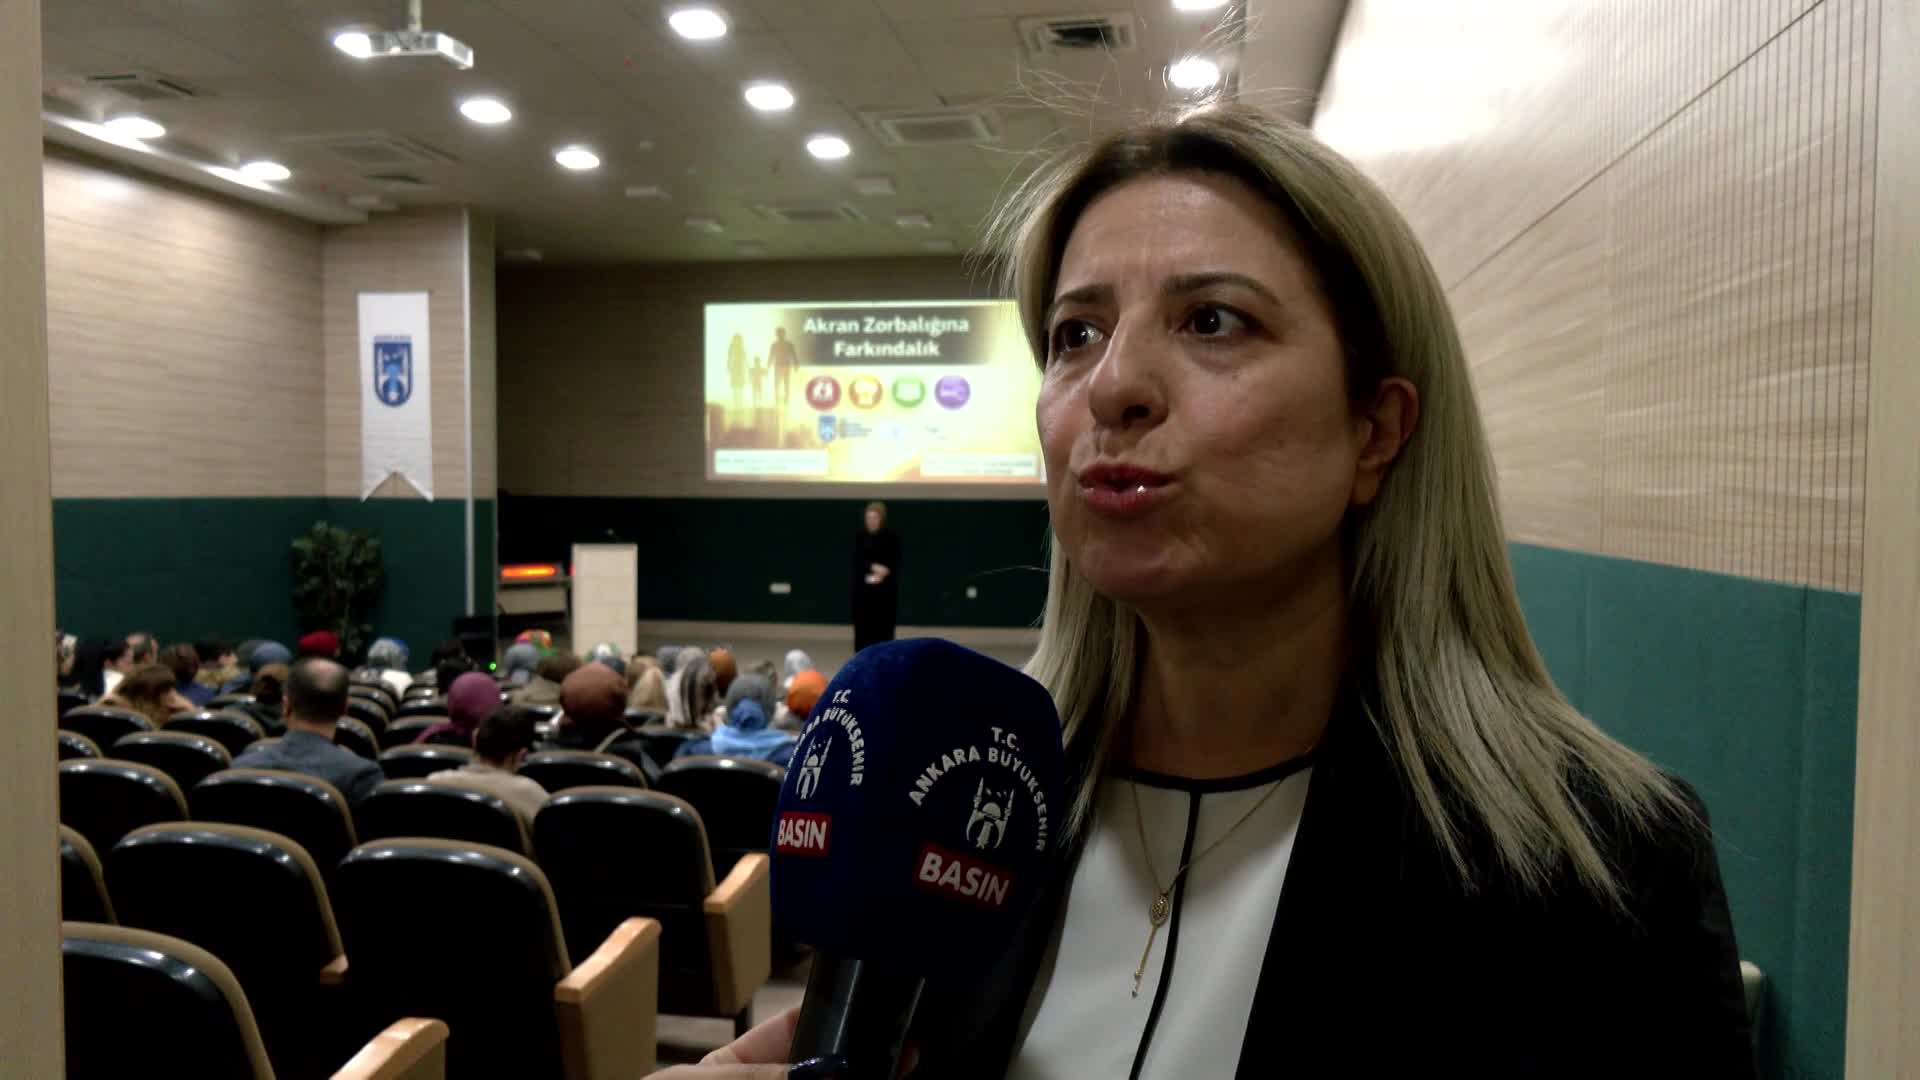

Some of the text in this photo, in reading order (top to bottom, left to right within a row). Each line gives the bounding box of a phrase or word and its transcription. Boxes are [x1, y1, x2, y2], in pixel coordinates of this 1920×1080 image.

[804, 317, 859, 333] Akran
[991, 726, 1021, 752] T.C.
[908, 745, 981, 806] ANKARA
[777, 818, 827, 850] BASIN
[919, 852, 1010, 905] BASIN
